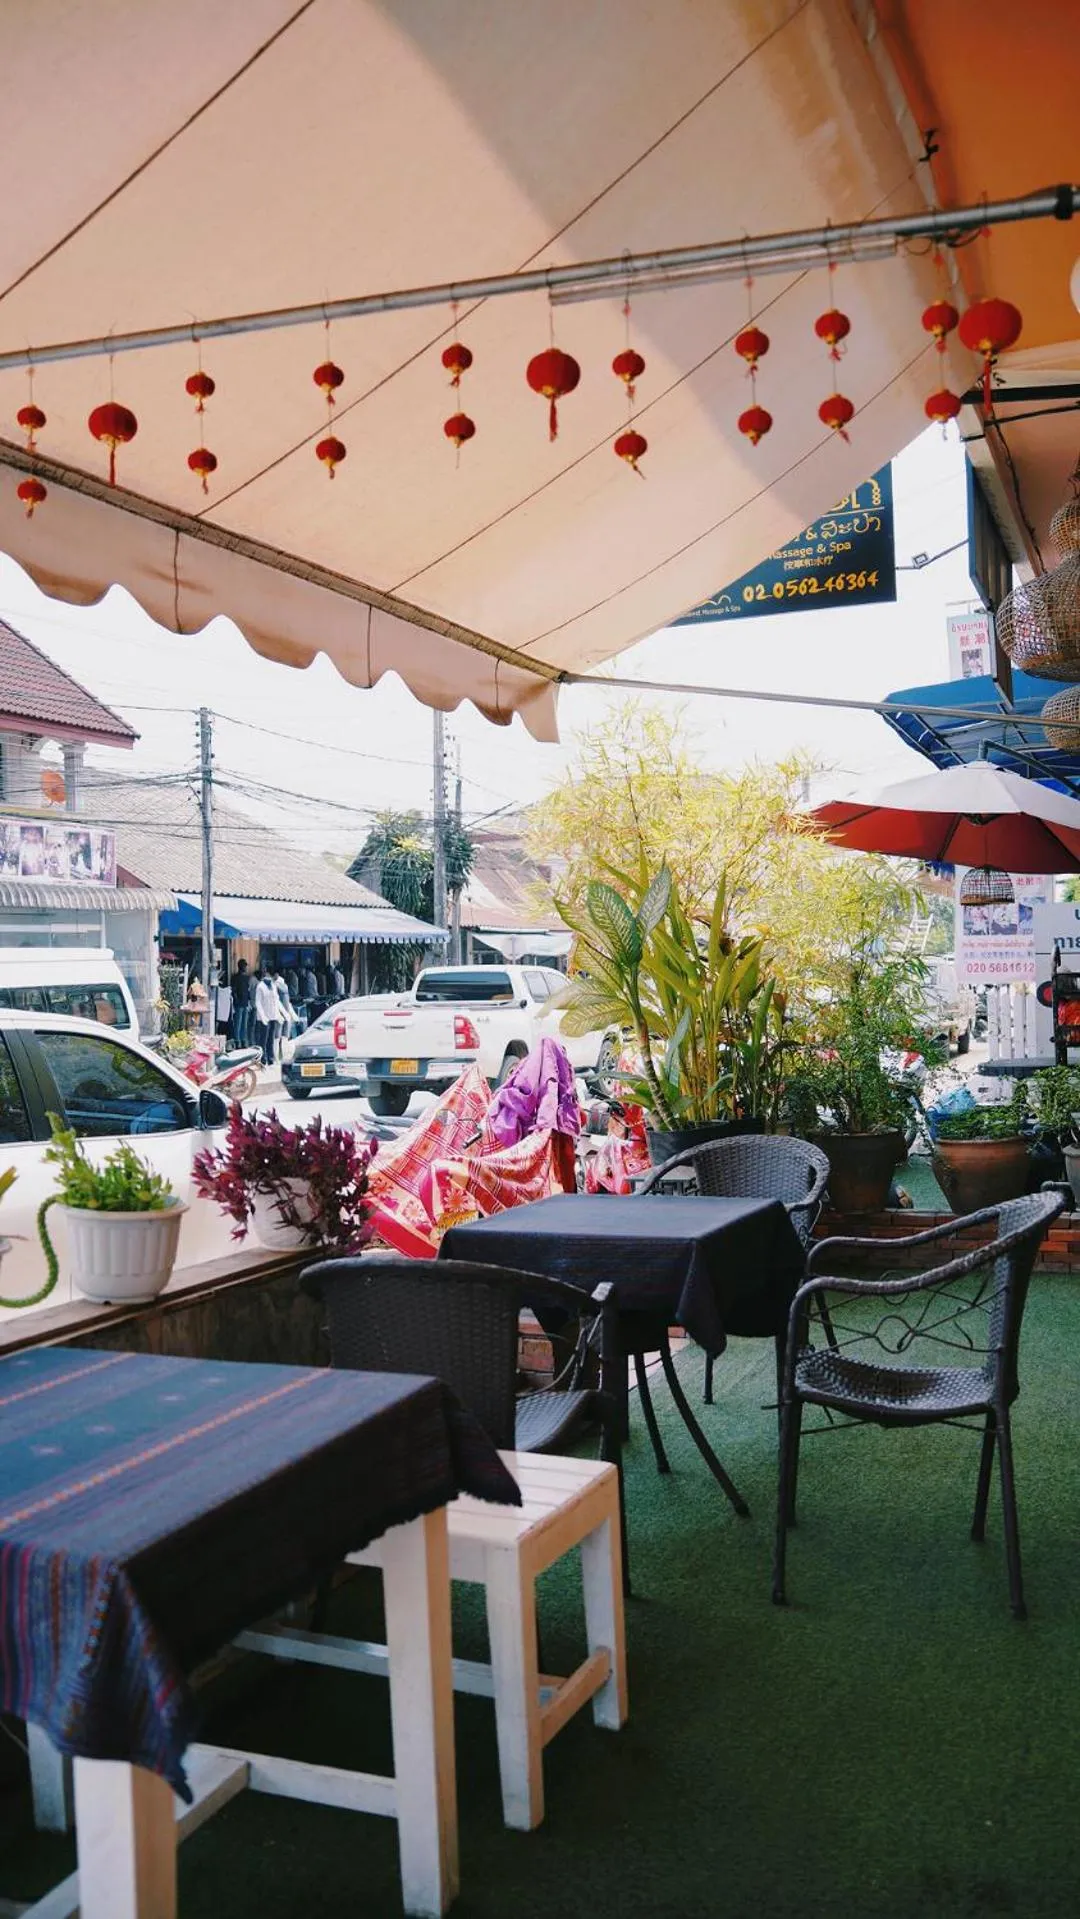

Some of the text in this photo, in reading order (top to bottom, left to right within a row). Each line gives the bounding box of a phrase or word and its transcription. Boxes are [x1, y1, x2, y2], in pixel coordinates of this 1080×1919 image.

[768, 541, 852, 559] assage & Spa
[967, 962, 987, 973] 020
